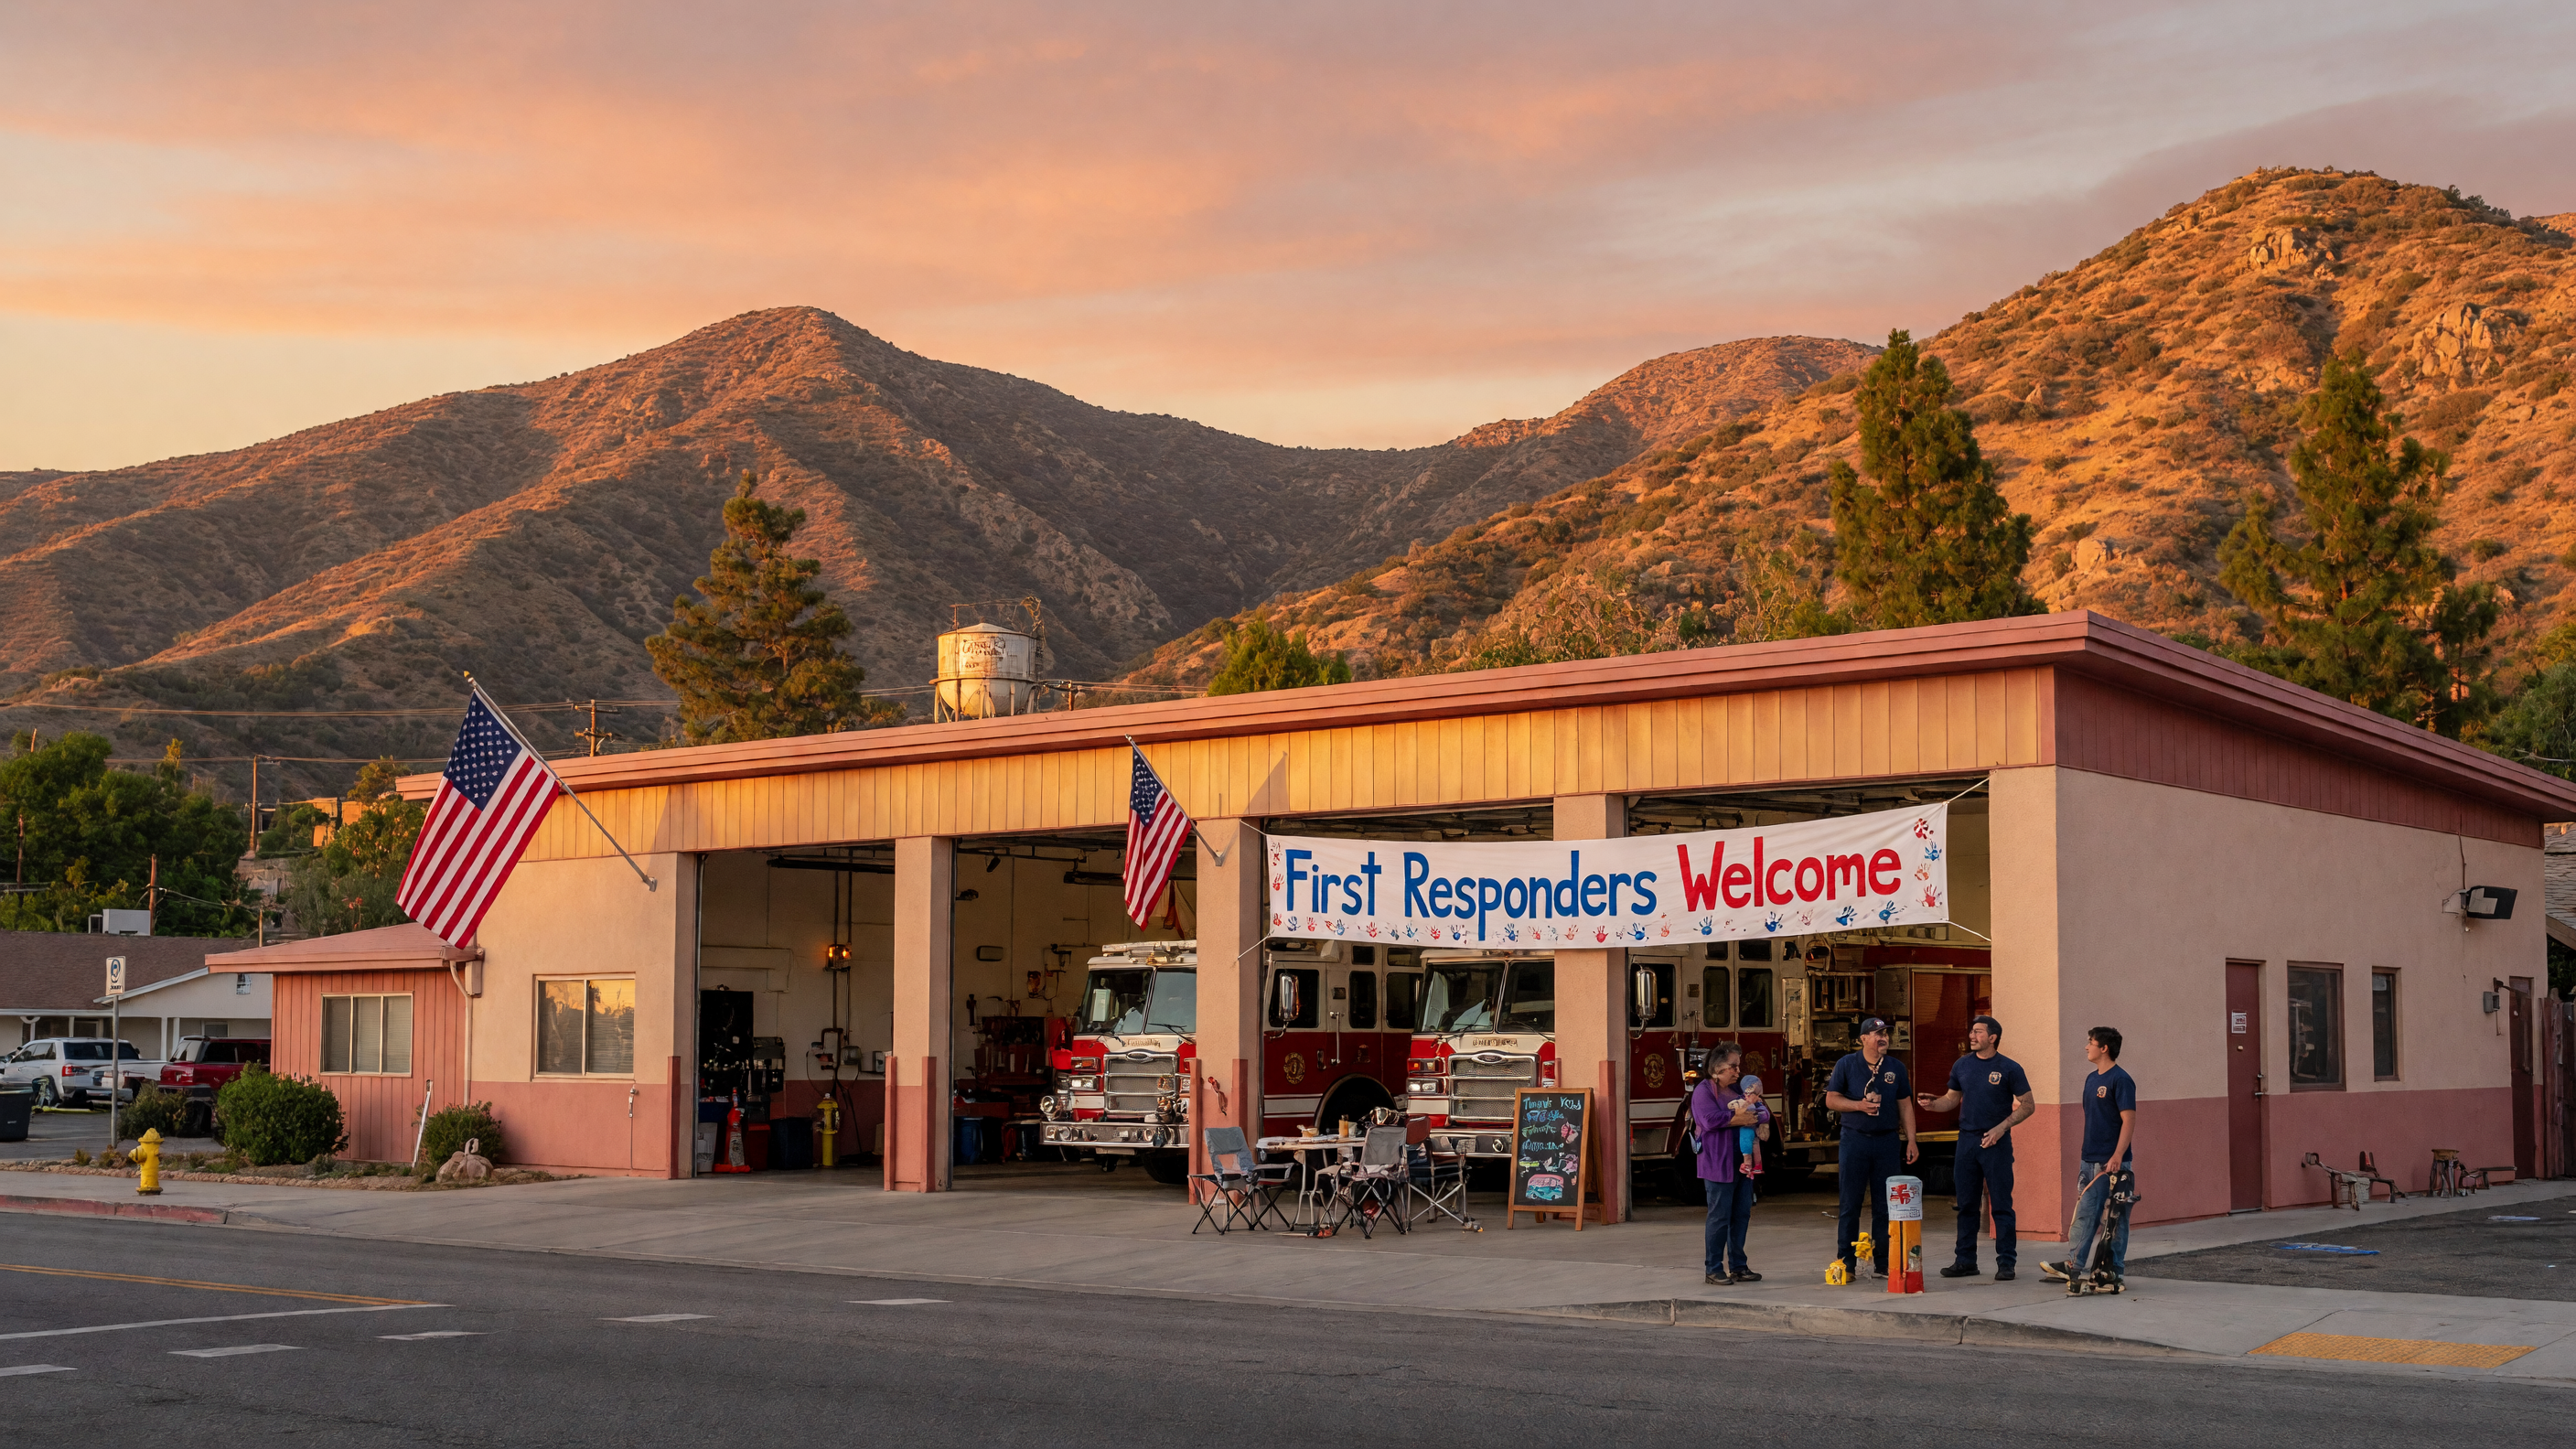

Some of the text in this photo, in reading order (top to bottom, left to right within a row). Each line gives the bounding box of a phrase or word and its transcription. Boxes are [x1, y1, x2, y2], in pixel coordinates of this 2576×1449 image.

[1285, 836, 1902, 941] First Responders Welcome
